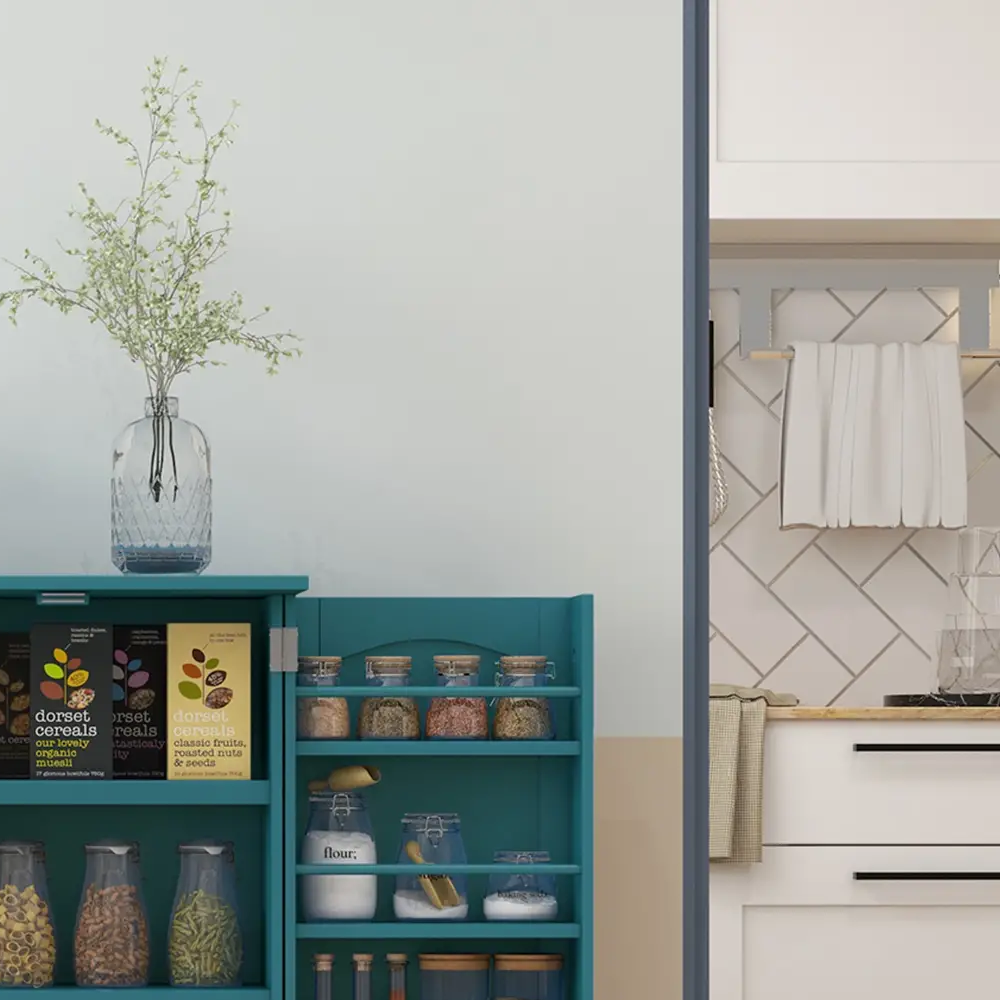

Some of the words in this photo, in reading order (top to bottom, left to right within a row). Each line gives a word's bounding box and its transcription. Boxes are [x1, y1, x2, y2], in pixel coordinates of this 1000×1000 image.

[35, 709, 91, 723] dorset
[112, 711, 151, 723] rset
[173, 709, 229, 723] dorset
[35, 724, 97, 737] cereals
[113, 724, 158, 737] reals
[173, 724, 236, 737] cereals
[36, 740, 56, 748] our
[57, 739, 90, 749] lovely
[174, 739, 211, 748] classic
[213, 739, 247, 748] fruits,
[36, 749, 77, 759] organic
[174, 749, 215, 757] roasted
[217, 749, 243, 757] nuts
[36, 759, 73, 767] muesli
[174, 759, 184, 767] &
[186, 758, 216, 767] seeds
